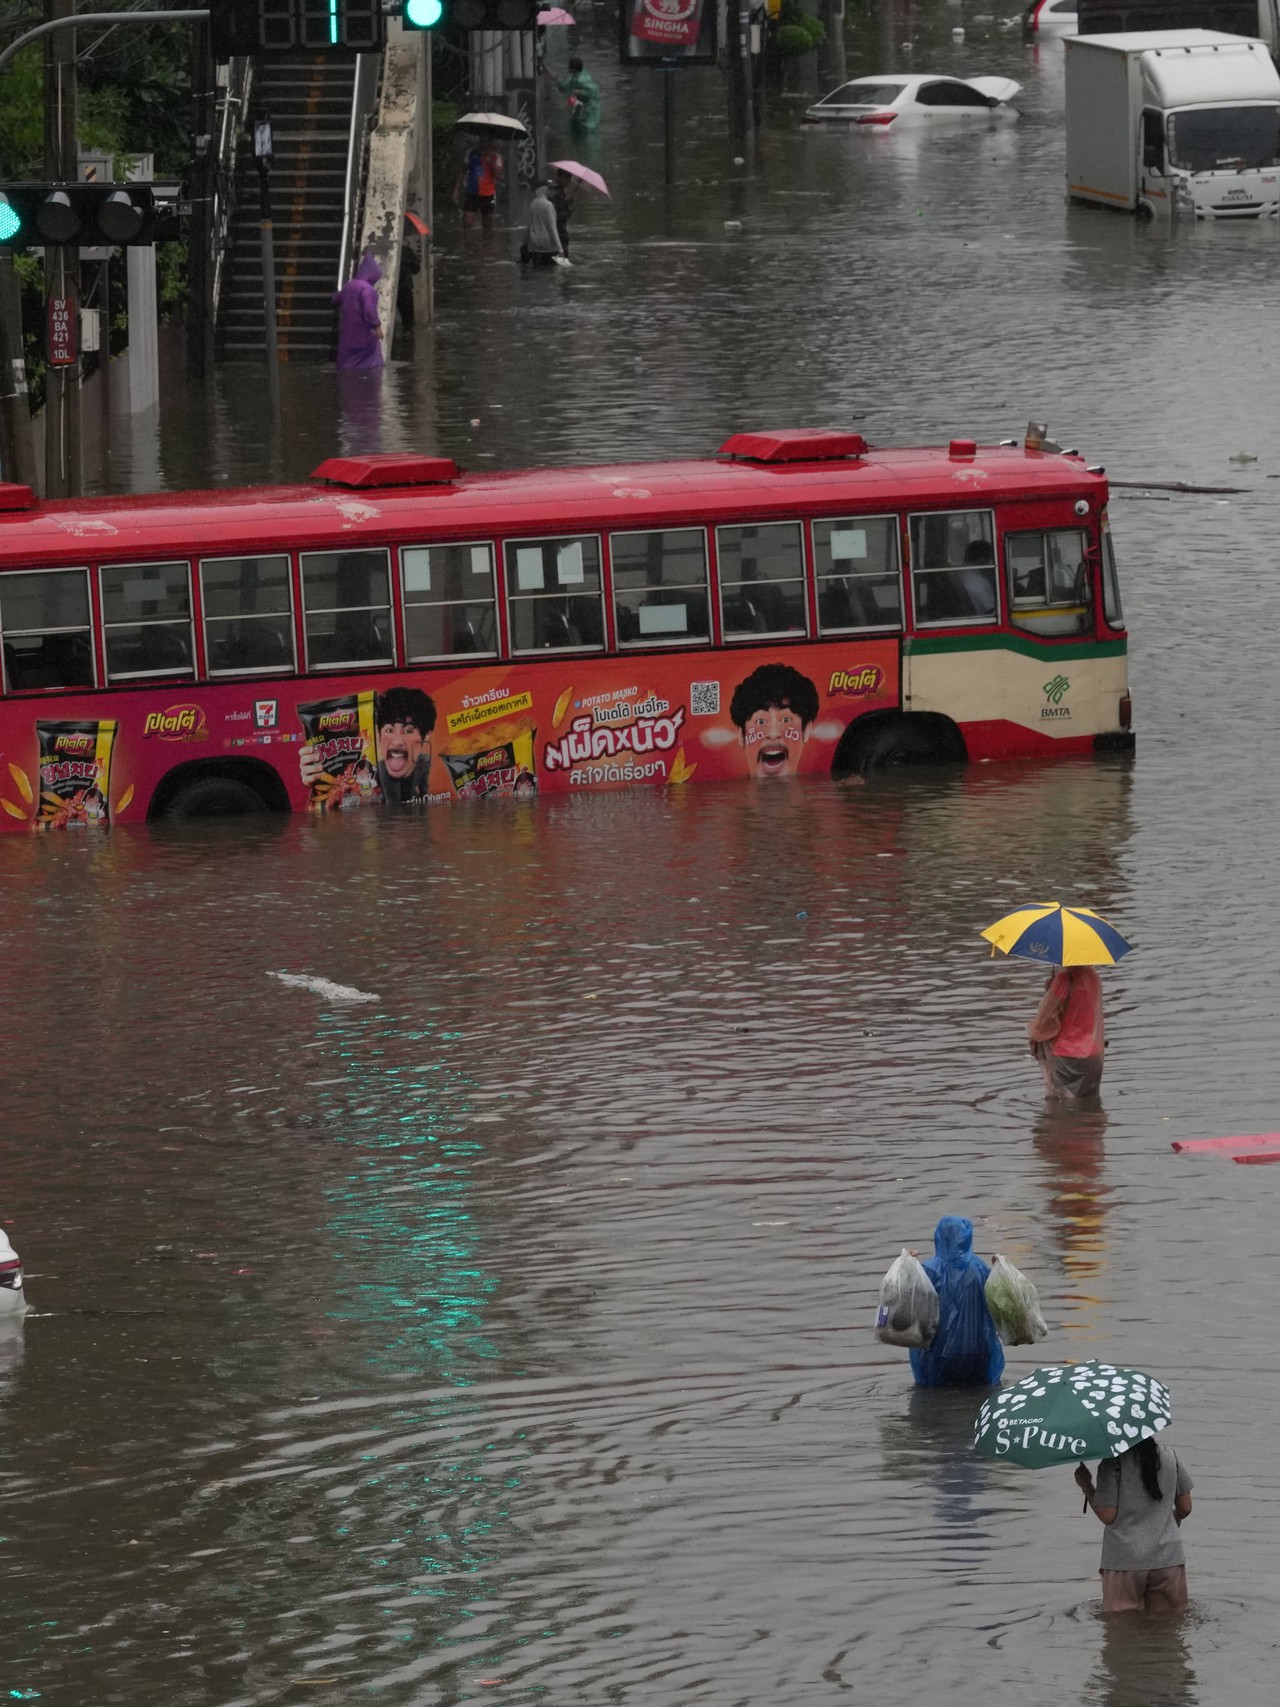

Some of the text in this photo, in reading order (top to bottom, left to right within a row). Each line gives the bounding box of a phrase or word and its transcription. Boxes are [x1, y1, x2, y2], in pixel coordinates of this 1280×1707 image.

[644, 17, 689, 33] SINGHA
[54, 300, 66, 310] SV
[52, 311, 69, 321] 436
[54, 322, 67, 332] BA
[53, 332, 69, 342] 421
[54, 349, 70, 358] 1DL
[582, 686, 638, 708] POTATO MAJIKO
[1041, 707, 1070, 718] BMTA
[745, 727, 765, 745] เผ็ด
[784, 726, 800, 741] นัว
[1009, 1418, 1044, 1426] BETAGRO
